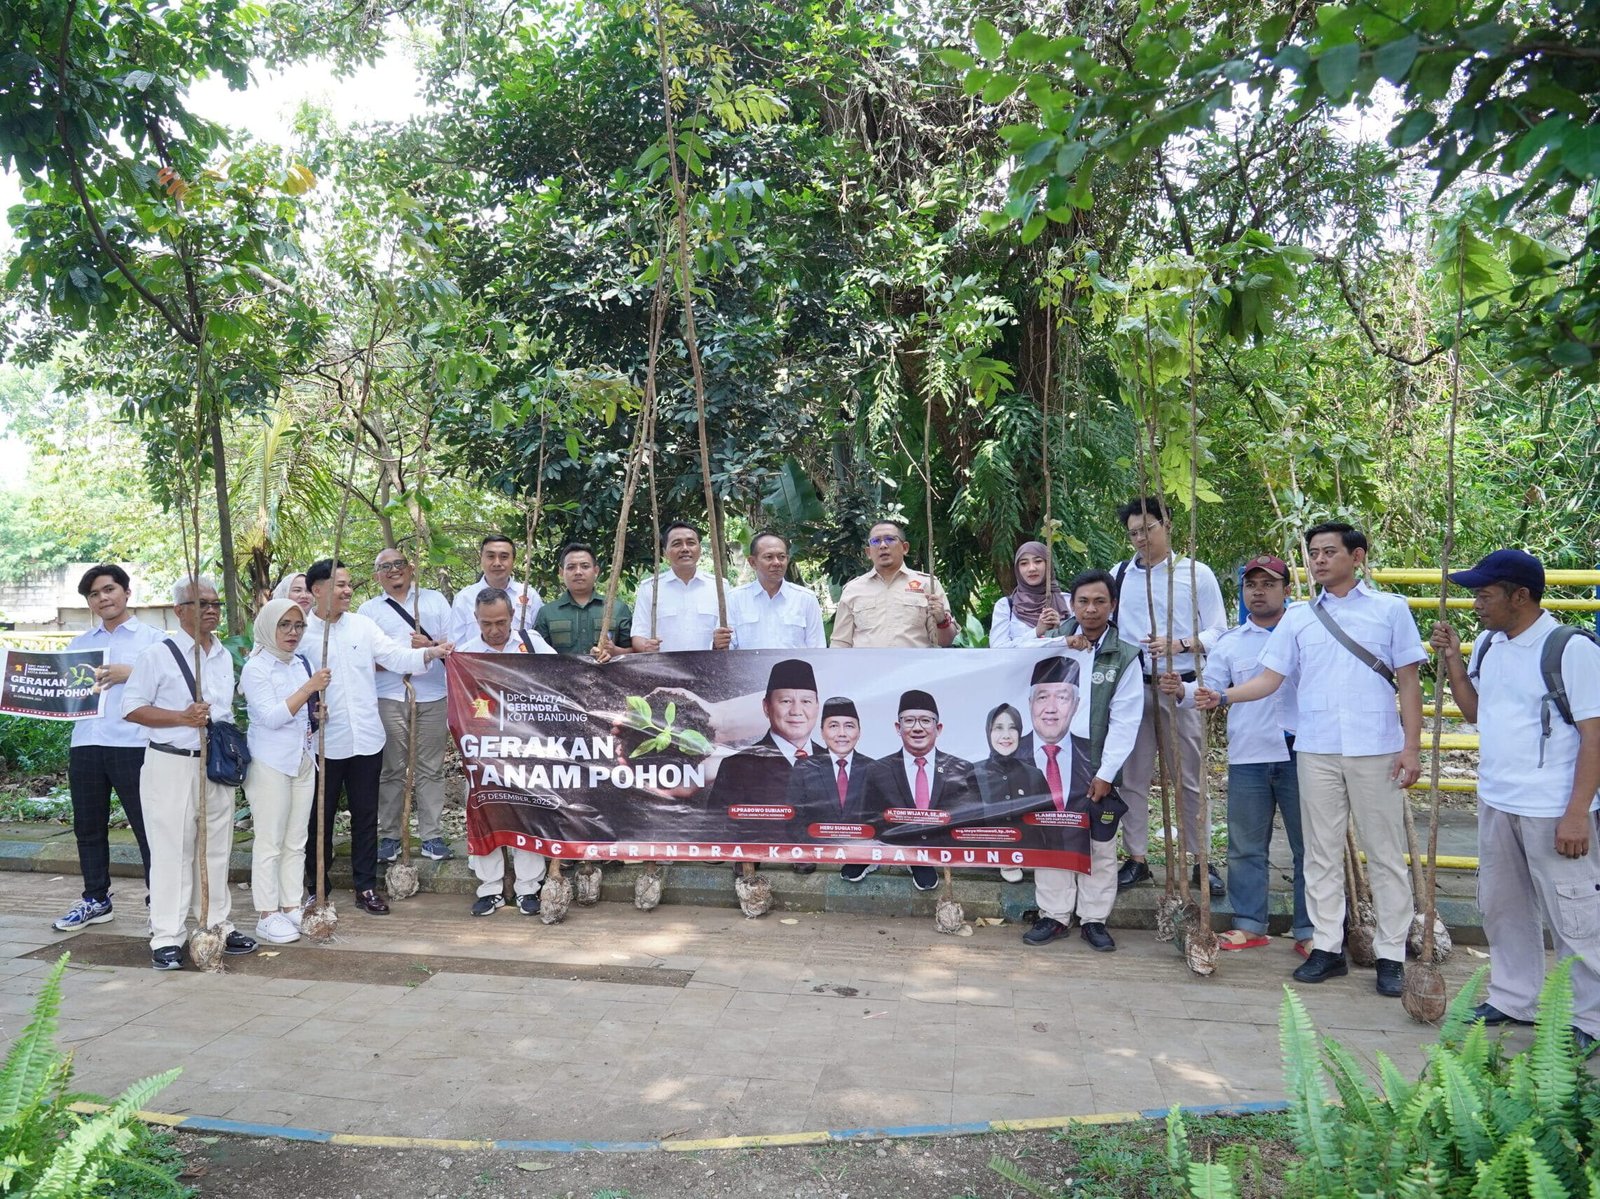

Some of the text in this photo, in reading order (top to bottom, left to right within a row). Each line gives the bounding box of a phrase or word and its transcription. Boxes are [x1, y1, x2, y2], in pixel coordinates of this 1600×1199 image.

[10, 675, 68, 687] GERAKAN
[9, 684, 55, 698] TANAM
[56, 687, 94, 698] POHON
[506, 693, 566, 704] DPC PARTAI
[506, 703, 560, 712] GERINDRA
[506, 713, 588, 723] KOTA BANDUNG
[460, 734, 615, 760] GERAKAN
[465, 763, 705, 790] TANAM POHON
[477, 794, 487, 803] 25
[487, 792, 532, 805] DESEMBER,
[516, 835, 1025, 864] DPC GERINDRA KOTA BANDUNG
